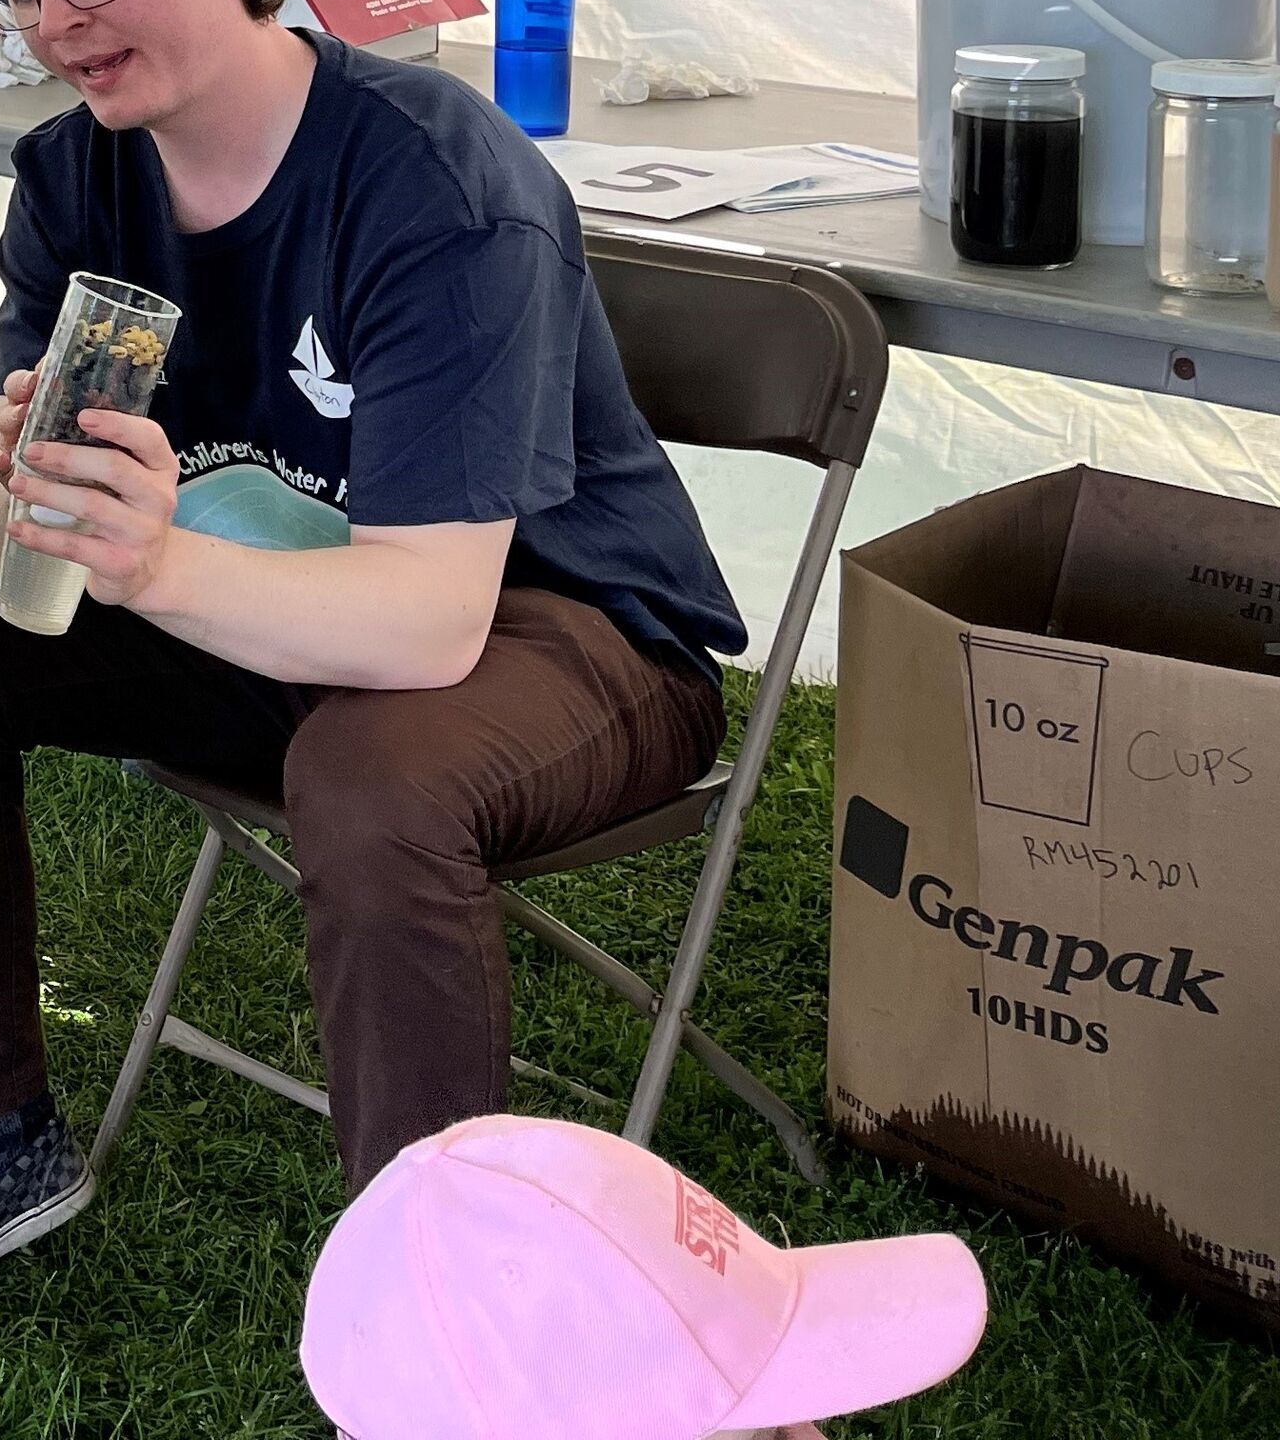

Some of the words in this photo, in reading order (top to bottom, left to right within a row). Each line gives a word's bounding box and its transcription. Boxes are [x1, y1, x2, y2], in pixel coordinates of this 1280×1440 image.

[581, 162, 715, 194] 5
[175, 441, 270, 475] Children's
[273, 448, 328, 494] Water
[1186, 564, 1254, 594] HAUT
[1240, 602, 1274, 624] UP
[984, 698, 1025, 732] 10
[1036, 718, 1080, 744] oz
[908, 874, 1225, 1015] Genpak
[967, 987, 1109, 1054] 10HDS
[837, 1085, 862, 1113] HOT
